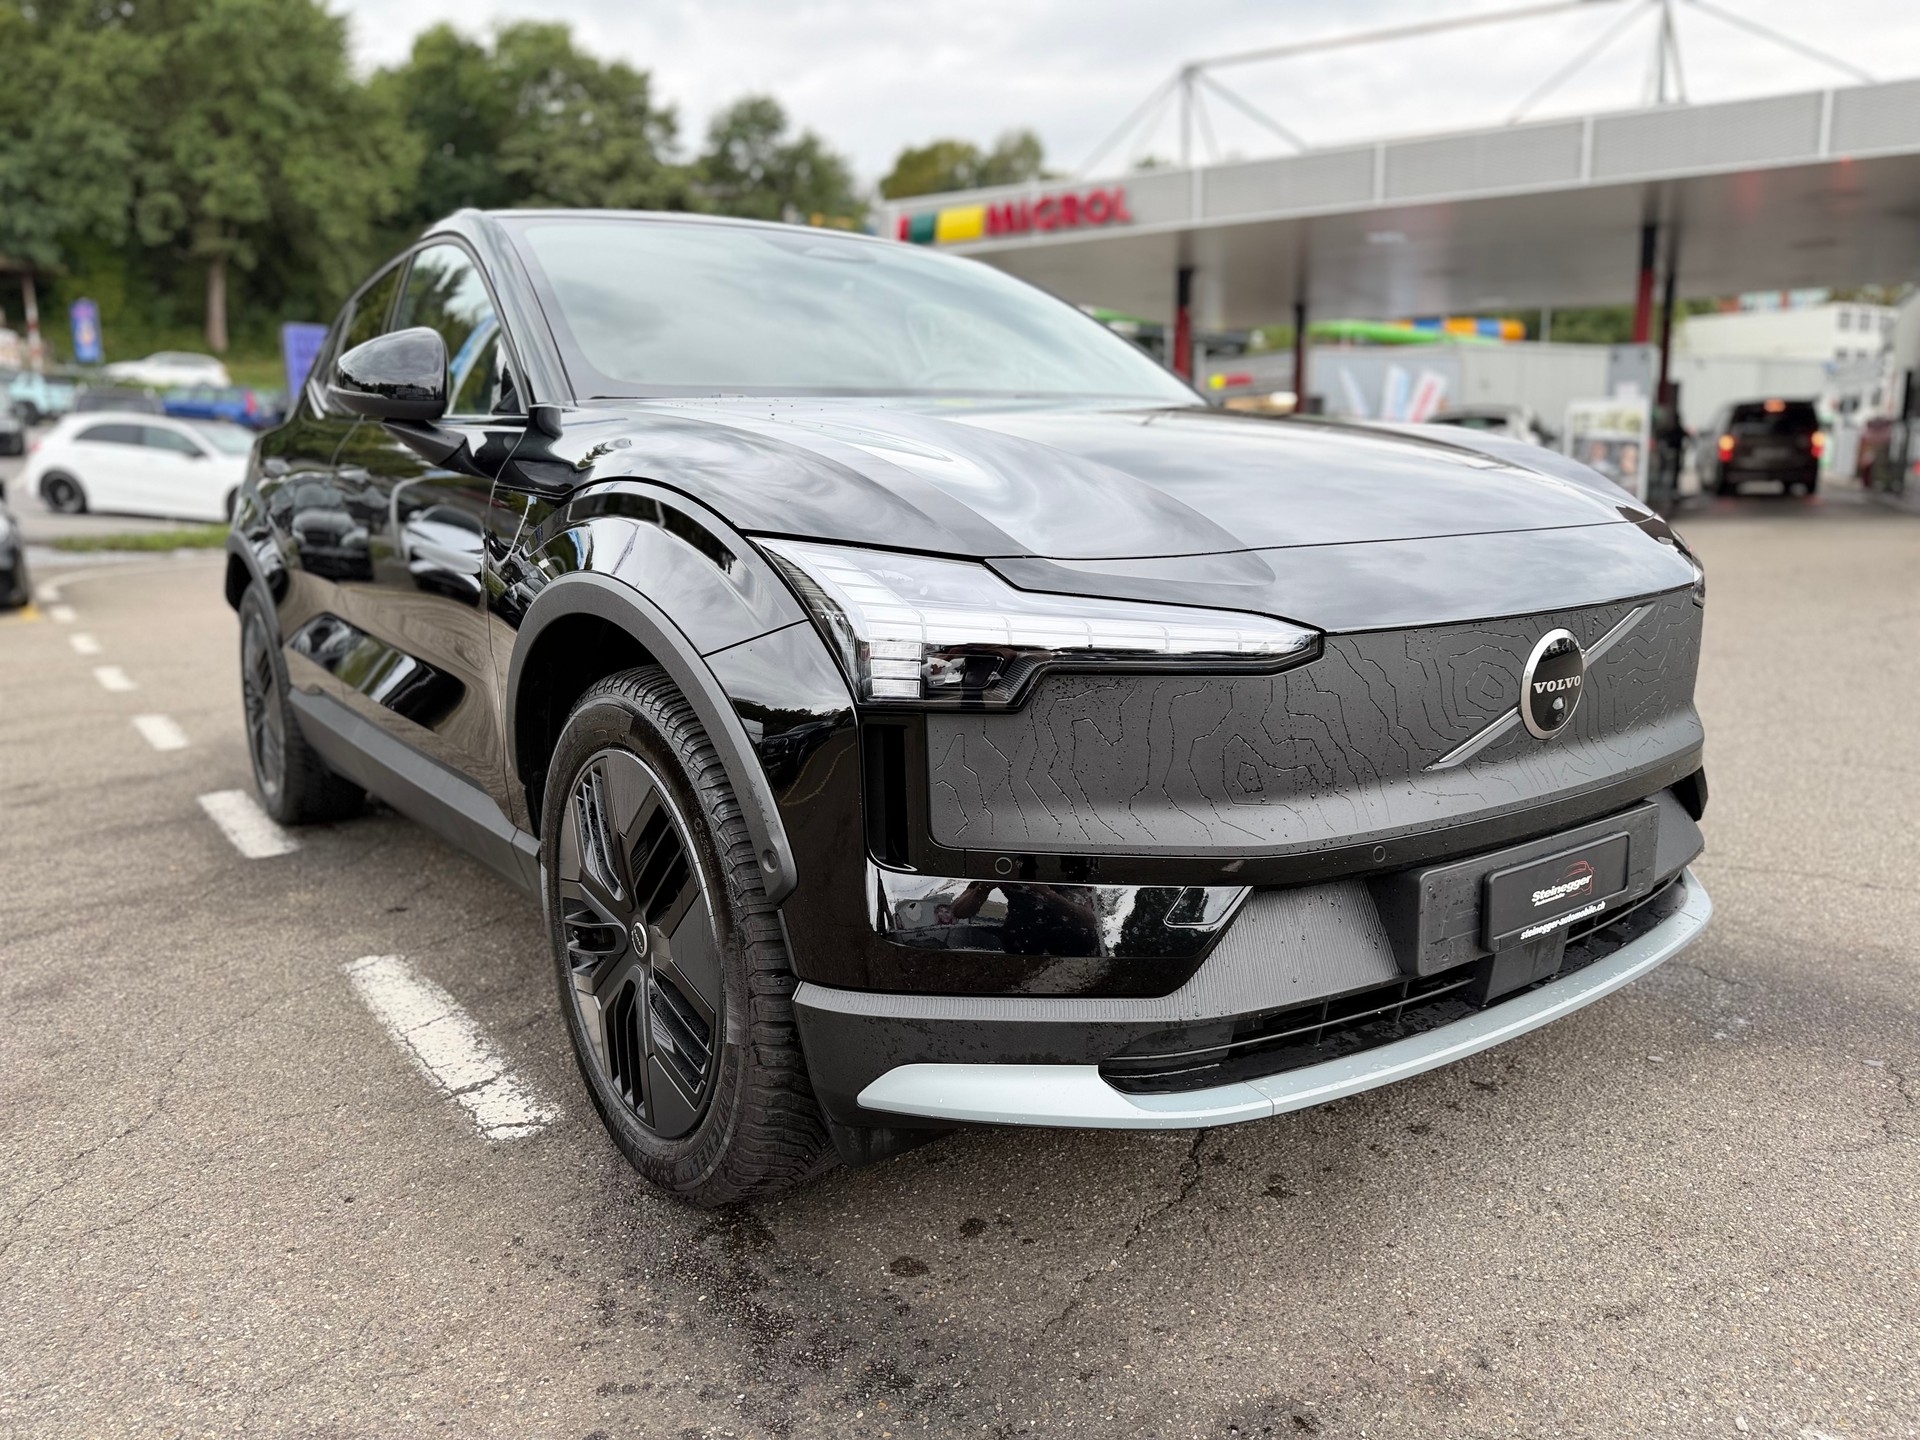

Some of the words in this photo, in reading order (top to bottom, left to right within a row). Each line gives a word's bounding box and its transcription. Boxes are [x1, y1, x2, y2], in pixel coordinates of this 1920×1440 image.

[986, 186, 1132, 236] MIGROL
[1533, 675, 1581, 694] VOLVO
[1531, 874, 1593, 902] Steinegger
[1520, 901, 1606, 940] steinegger-automobile.ch
